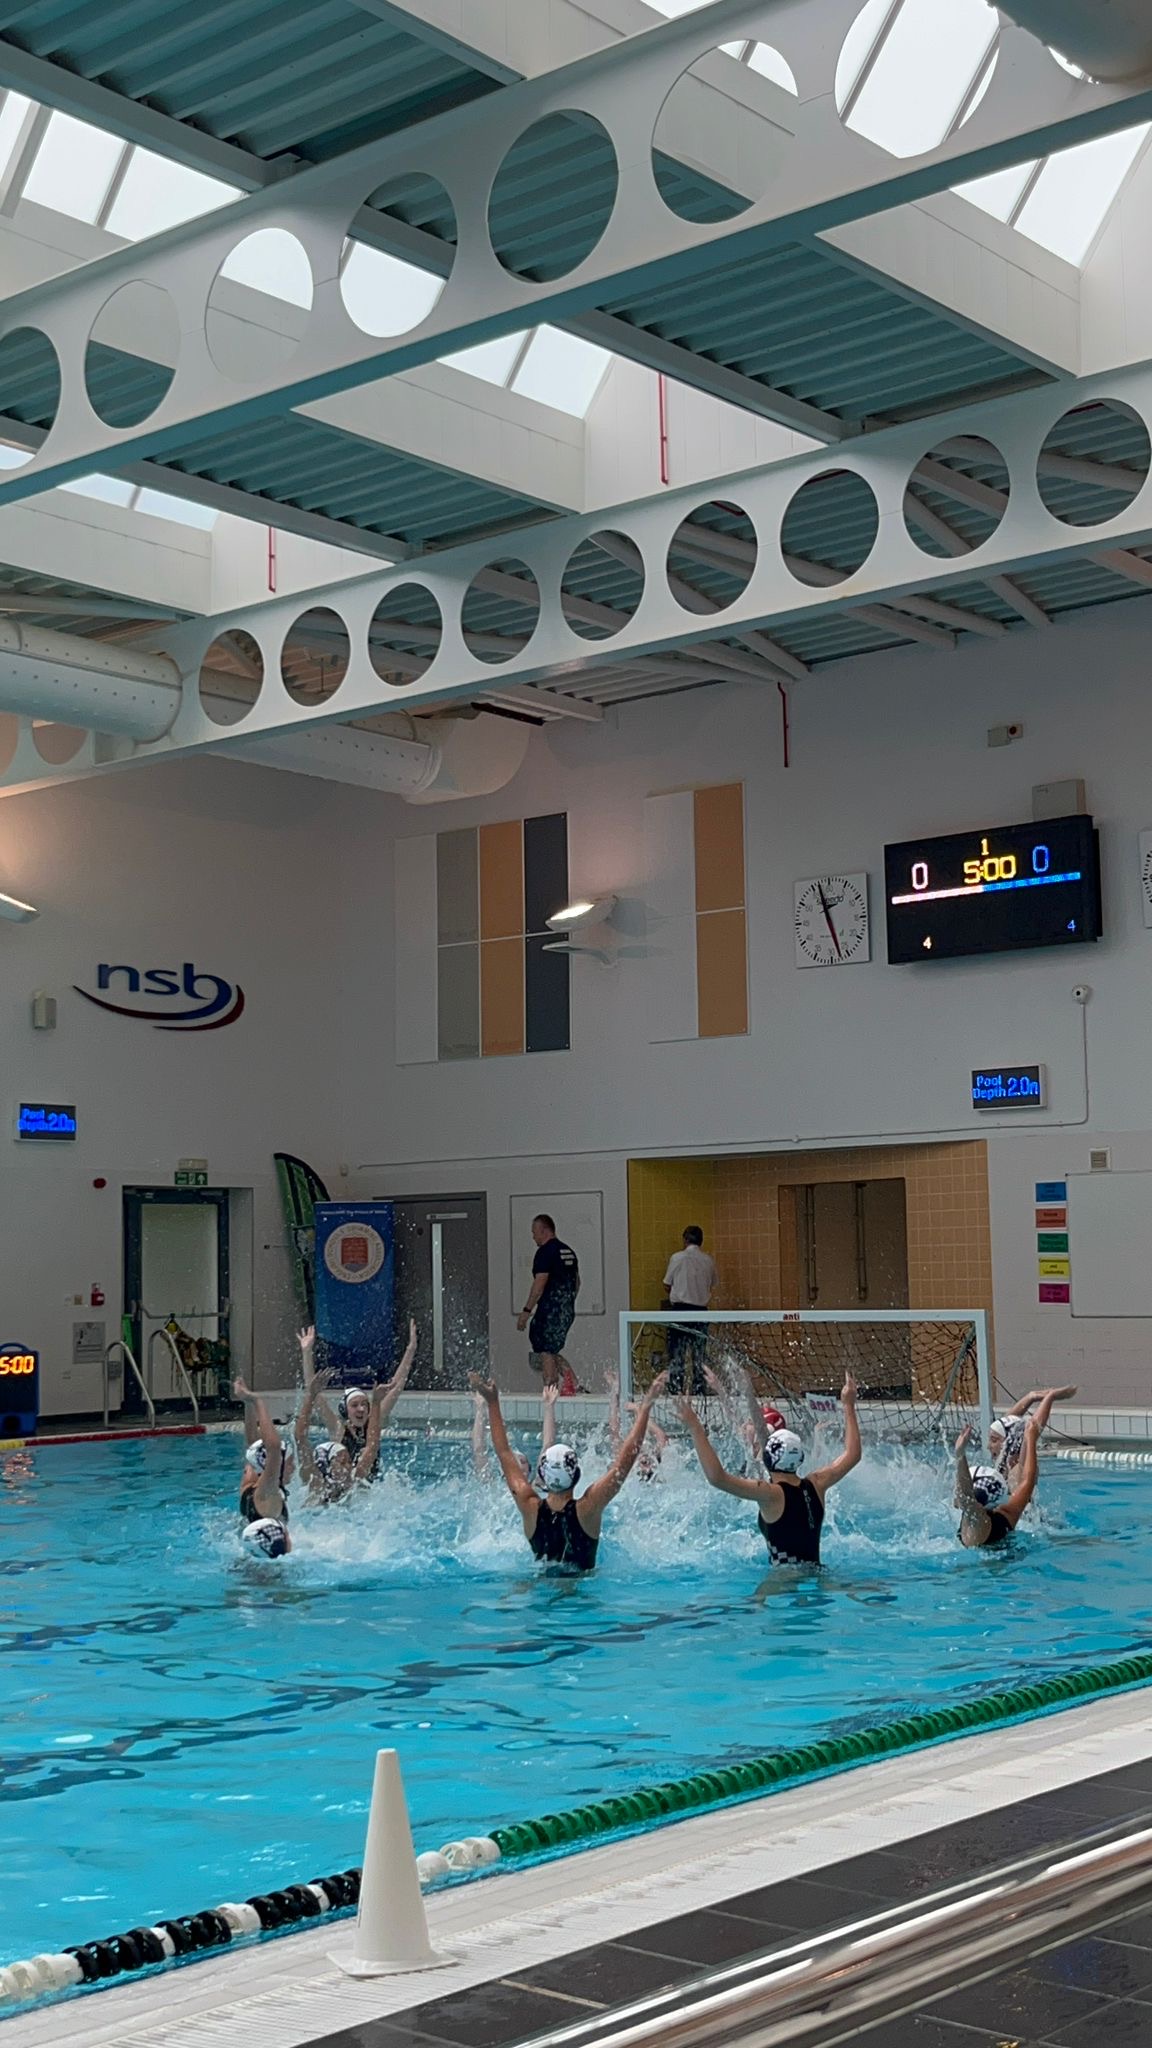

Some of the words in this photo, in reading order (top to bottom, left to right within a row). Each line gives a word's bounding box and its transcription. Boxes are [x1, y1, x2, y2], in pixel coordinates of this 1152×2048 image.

[981, 838, 990, 856] 1
[1032, 845, 1049, 873] 0
[911, 862, 929, 890] 0
[963, 855, 1017, 884] 5:00
[1067, 919, 1077, 932] 4
[922, 936, 932, 950] 4
[97, 962, 233, 1007] nsb
[976, 1074, 1002, 1087] Pool
[972, 1086, 1006, 1101] Depth
[783, 1312, 800, 1321] anti
[0, 1356, 35, 1375] 5:00
[809, 1399, 837, 1413] anti
